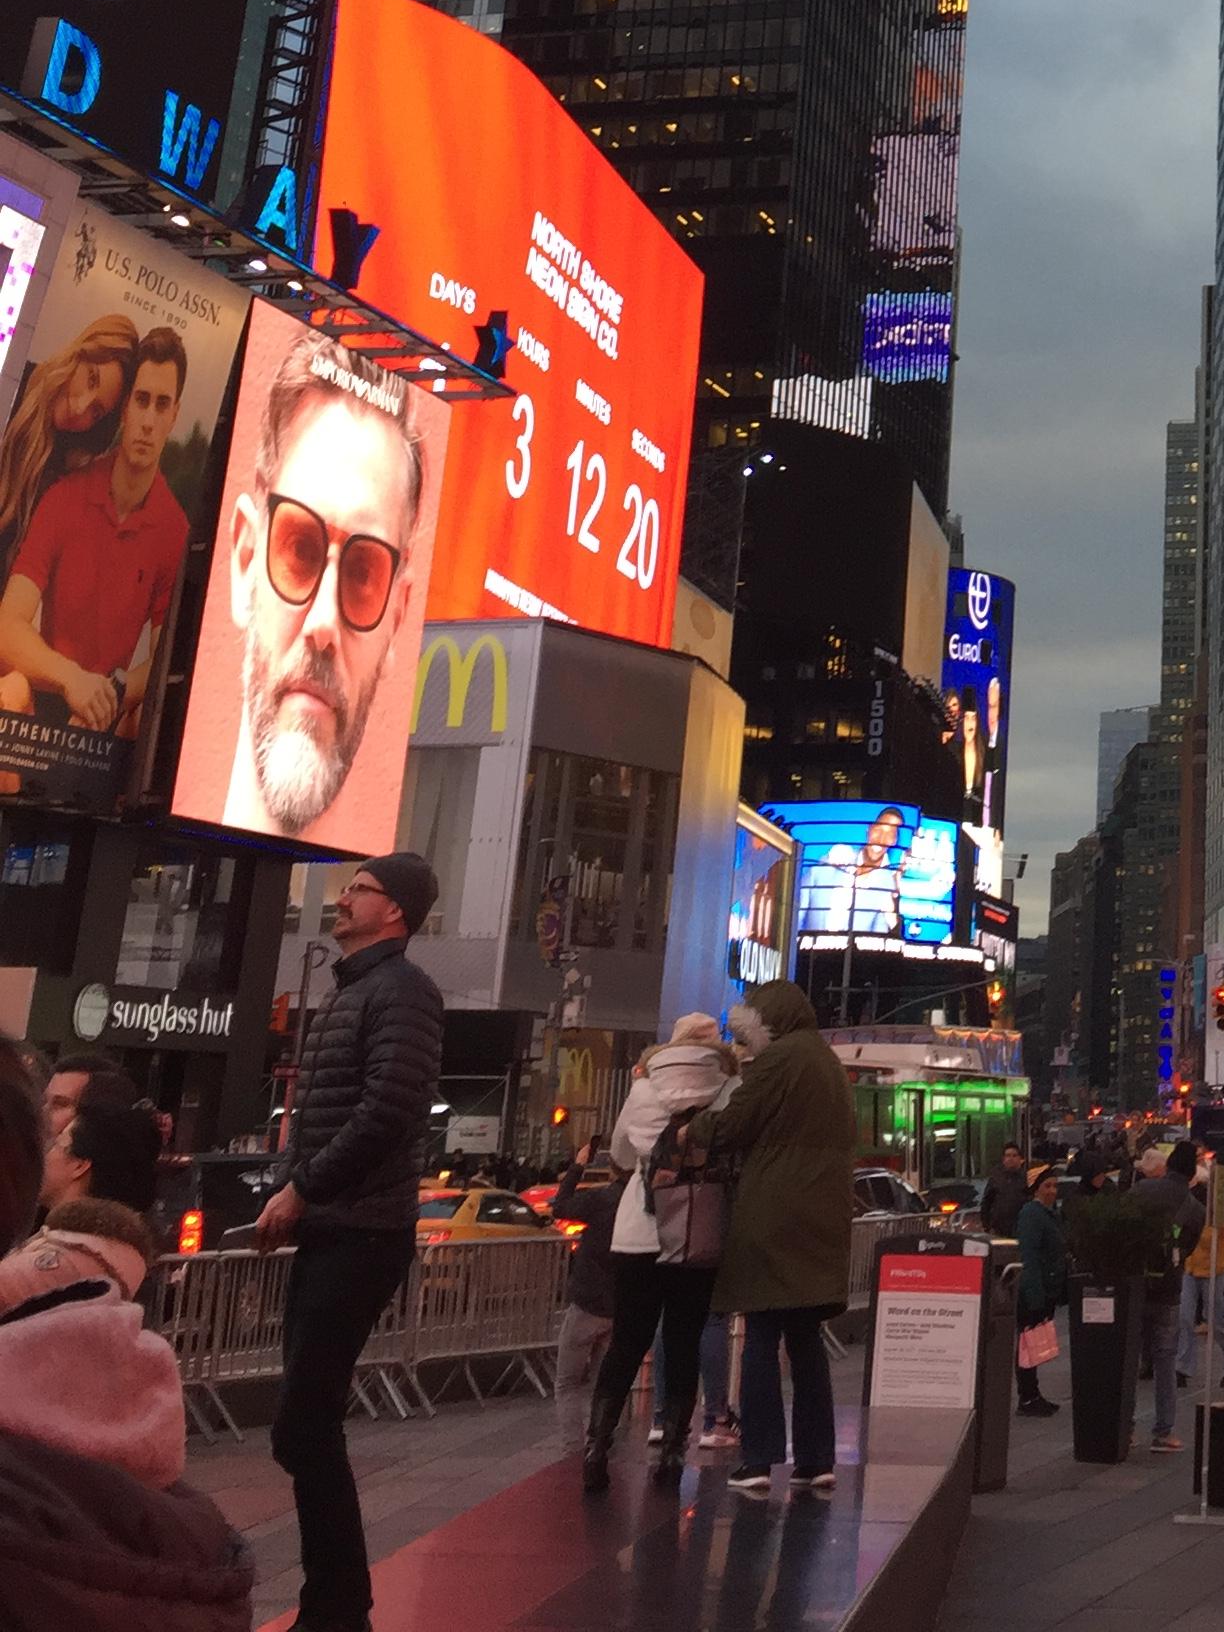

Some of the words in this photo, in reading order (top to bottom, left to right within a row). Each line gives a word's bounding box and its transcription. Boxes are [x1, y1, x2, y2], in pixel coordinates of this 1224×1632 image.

[105, 249, 132, 280] U.S.
[135, 265, 178, 302] POLO
[179, 290, 221, 326] ASSN.
[531, 211, 582, 280] NORTH
[580, 260, 623, 325] SHORE
[123, 291, 156, 315] SINCE
[161, 310, 188, 330] 1890
[429, 272, 476, 315] DAYS
[525, 246, 569, 310] NEON
[597, 321, 618, 360] CO.
[516, 326, 550, 372] HOURS
[575, 378, 612, 426] MINUTES
[505, 394, 535, 499] 3
[566, 440, 607, 554] 12
[616, 484, 660, 590] 20
[867, 680, 885, 756] 1500
[111, 994, 197, 1042] sunglass
[199, 997, 234, 1037] hut
[888, 1307, 910, 1316] Word
[923, 1308, 937, 1317] the
[938, 1308, 964, 1318] Street
